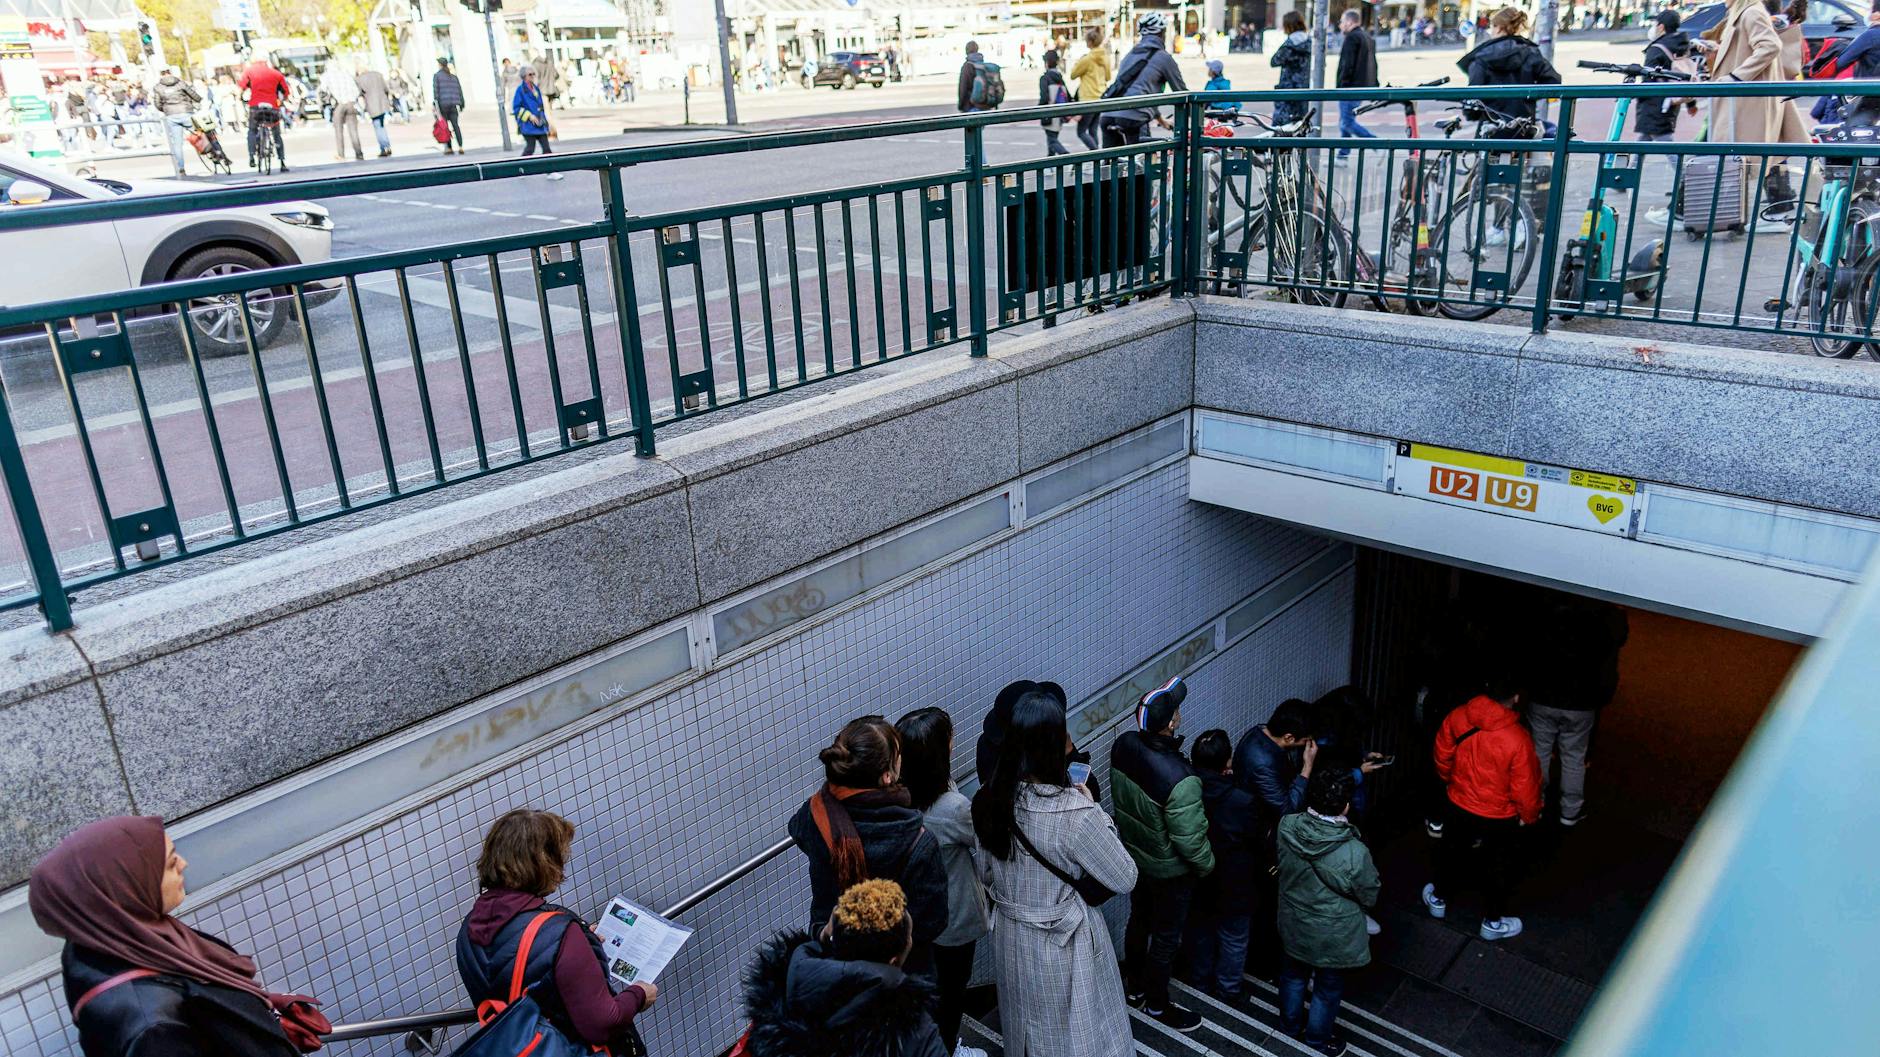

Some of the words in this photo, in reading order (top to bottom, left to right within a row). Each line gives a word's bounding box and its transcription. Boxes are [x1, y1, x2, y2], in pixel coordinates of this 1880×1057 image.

[1400, 444, 1408, 455] P
[1435, 470, 1474, 498] U2
[1491, 480, 1532, 508] U9
[1596, 503, 1614, 514] BVG
